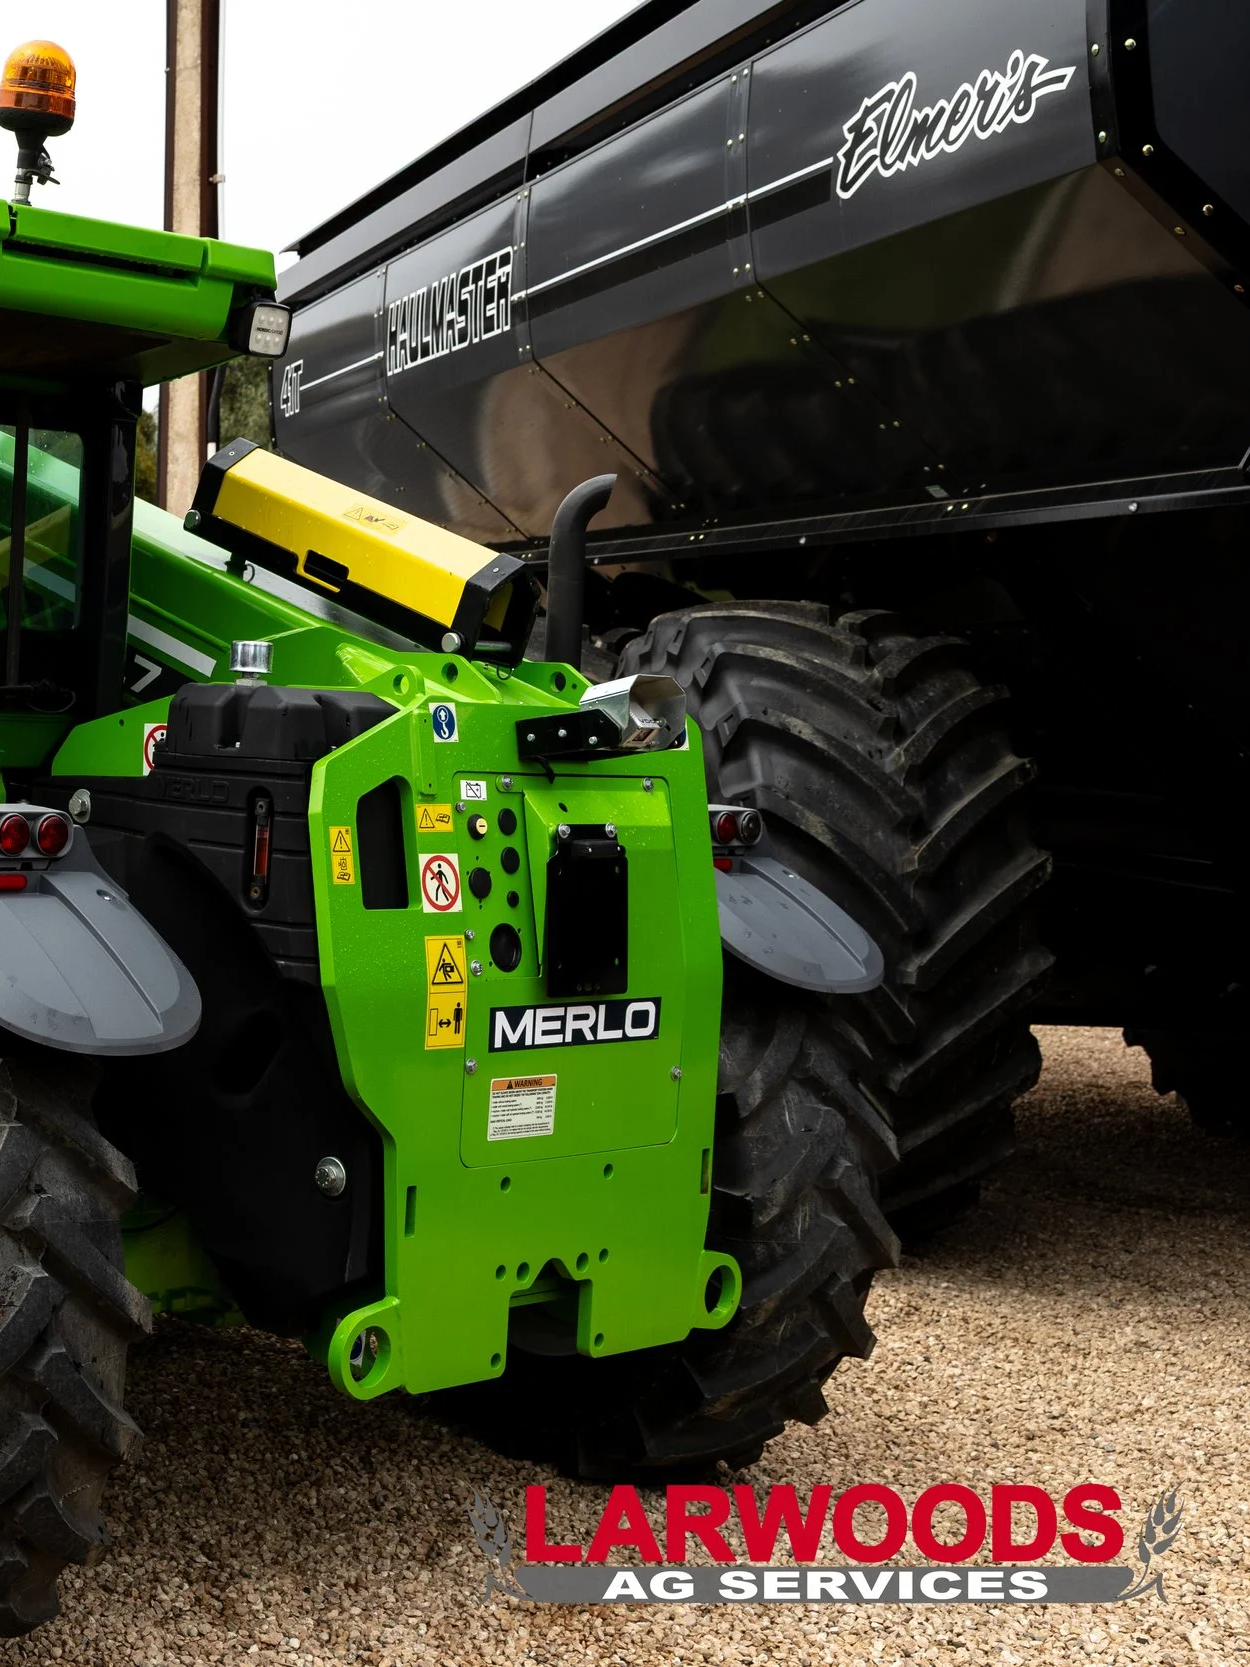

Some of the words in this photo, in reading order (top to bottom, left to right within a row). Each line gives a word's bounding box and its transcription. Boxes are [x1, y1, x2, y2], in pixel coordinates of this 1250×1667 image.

[836, 49, 1077, 199] Elmer's
[387, 246, 513, 376] HAULMASTER
[494, 1001, 657, 1049] MERLO
[514, 1078, 543, 1088] WARNING
